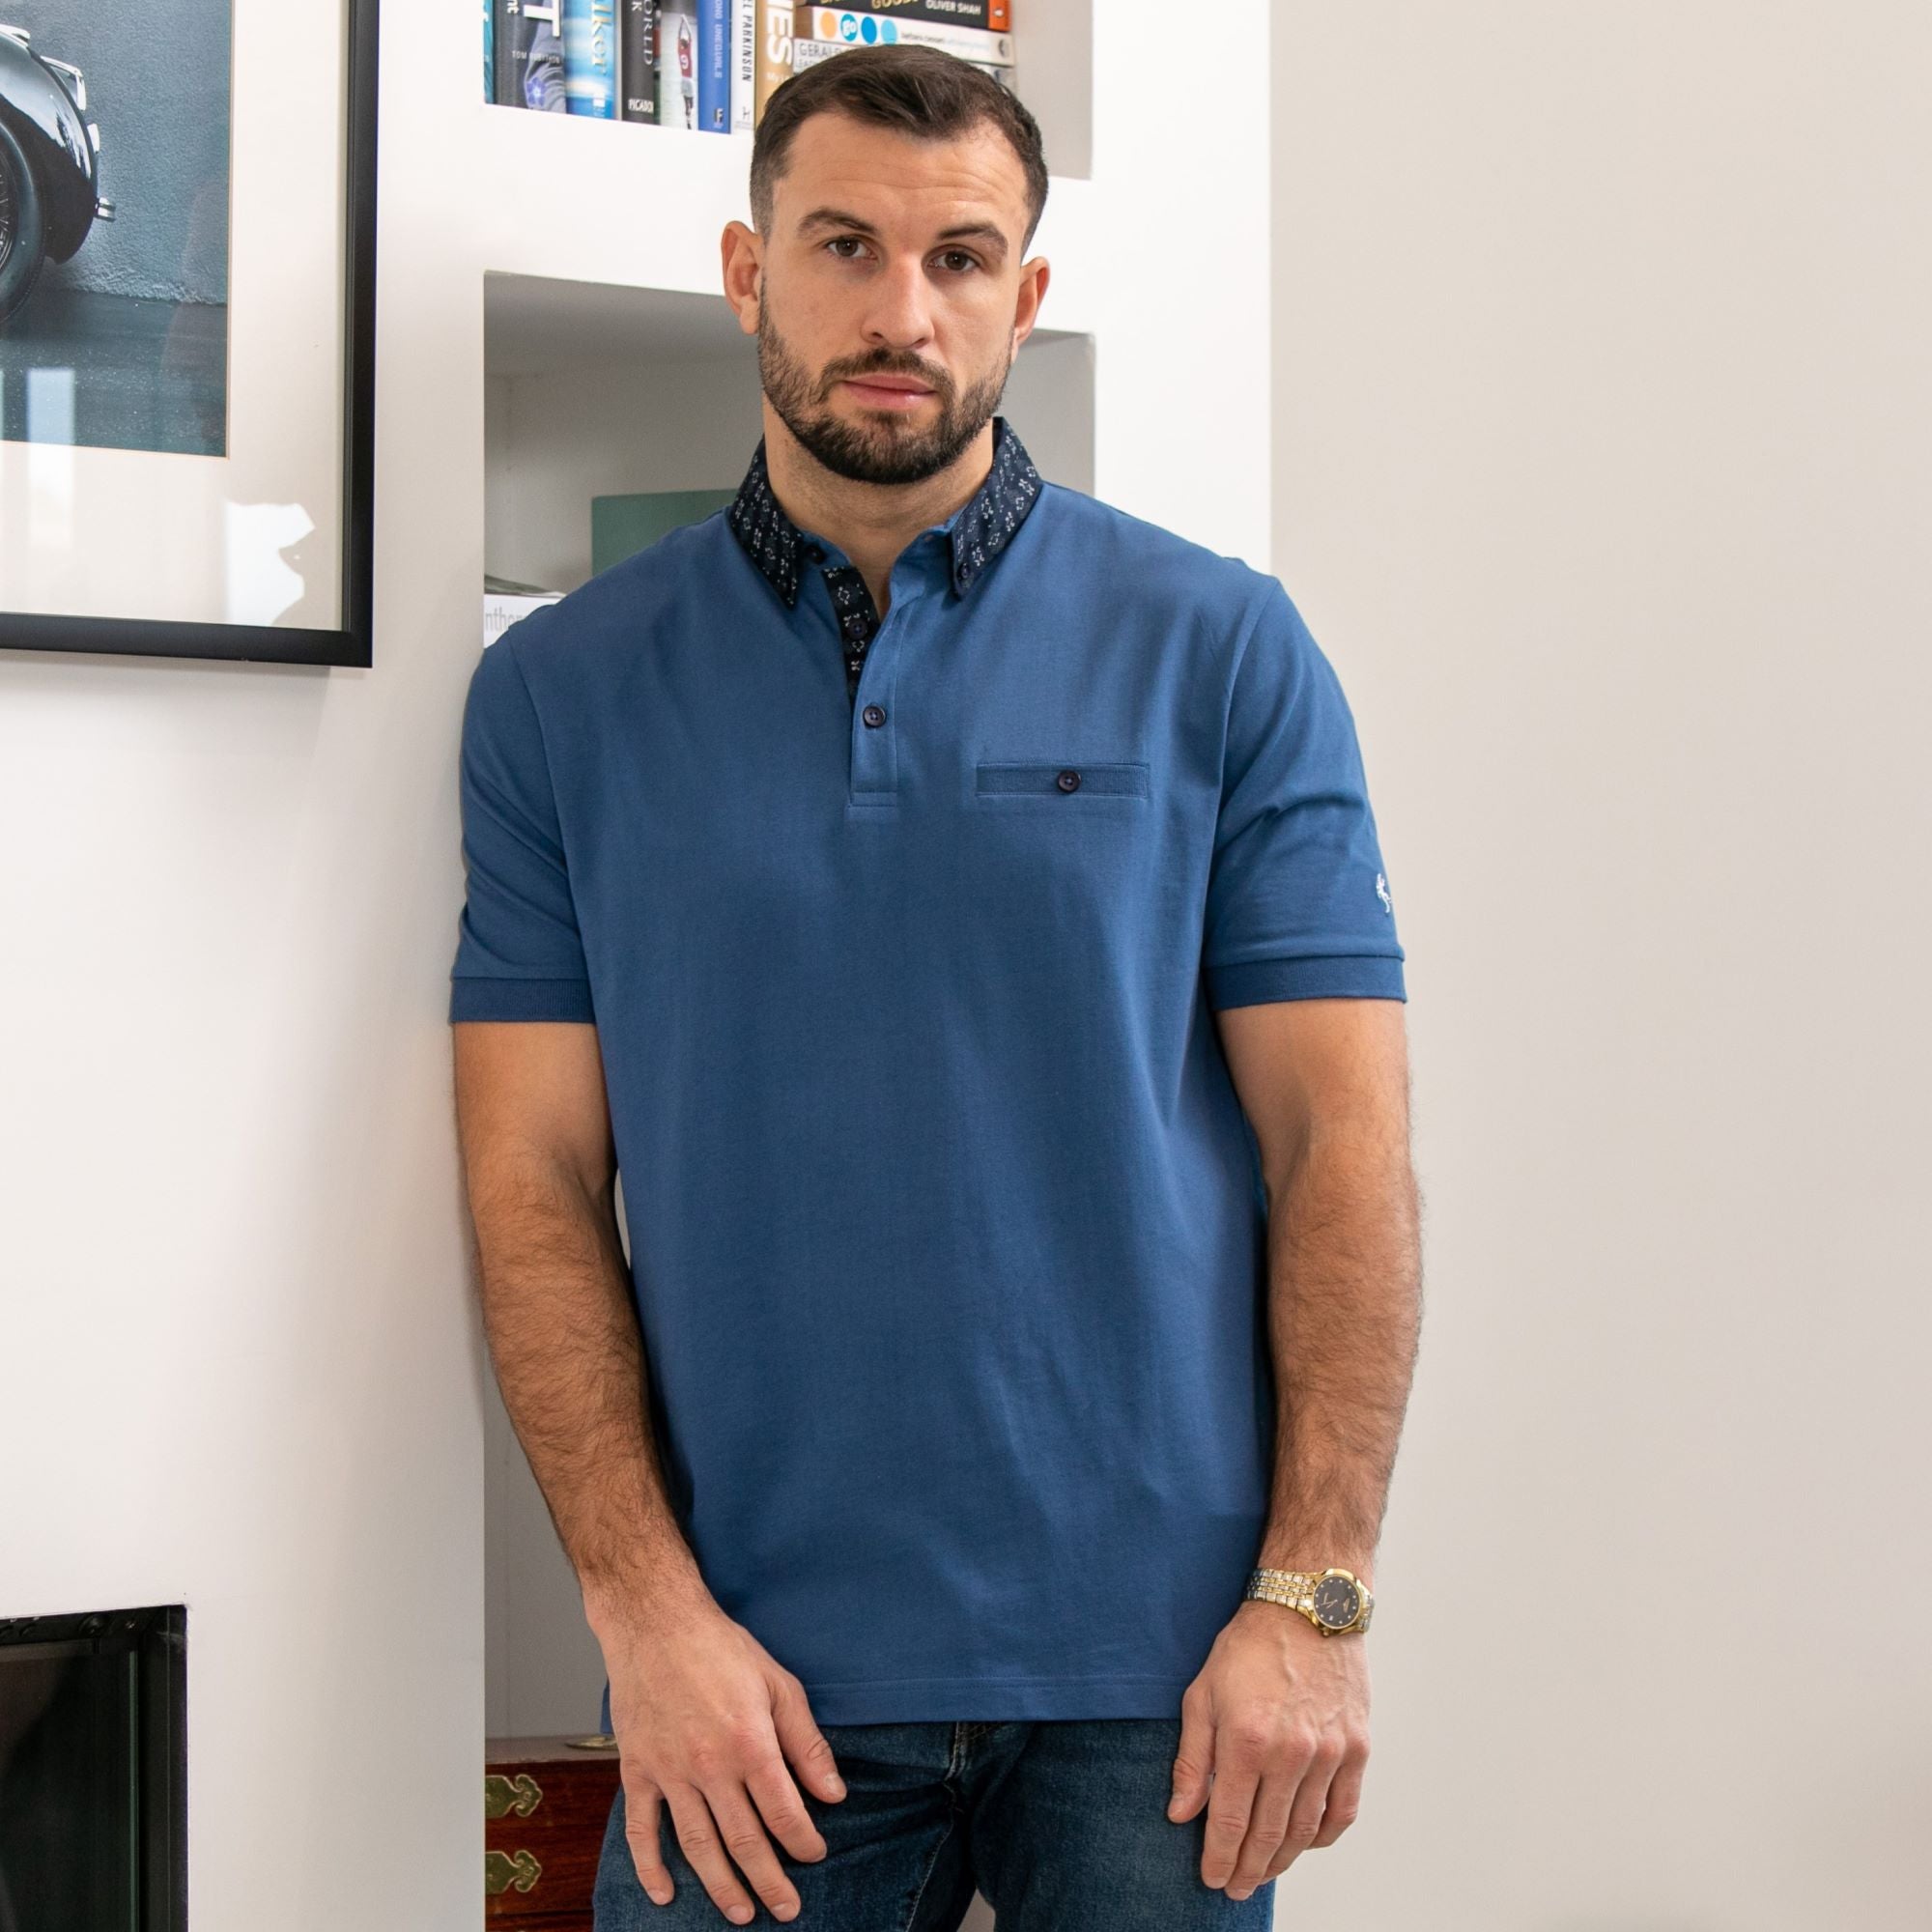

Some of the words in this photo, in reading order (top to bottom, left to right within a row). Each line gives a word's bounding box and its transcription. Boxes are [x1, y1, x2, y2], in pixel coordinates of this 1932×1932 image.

[925, 0, 956, 12] OLIVER
[957, 3, 981, 14] SHAH
[742, 14, 753, 82] PARKINSON
